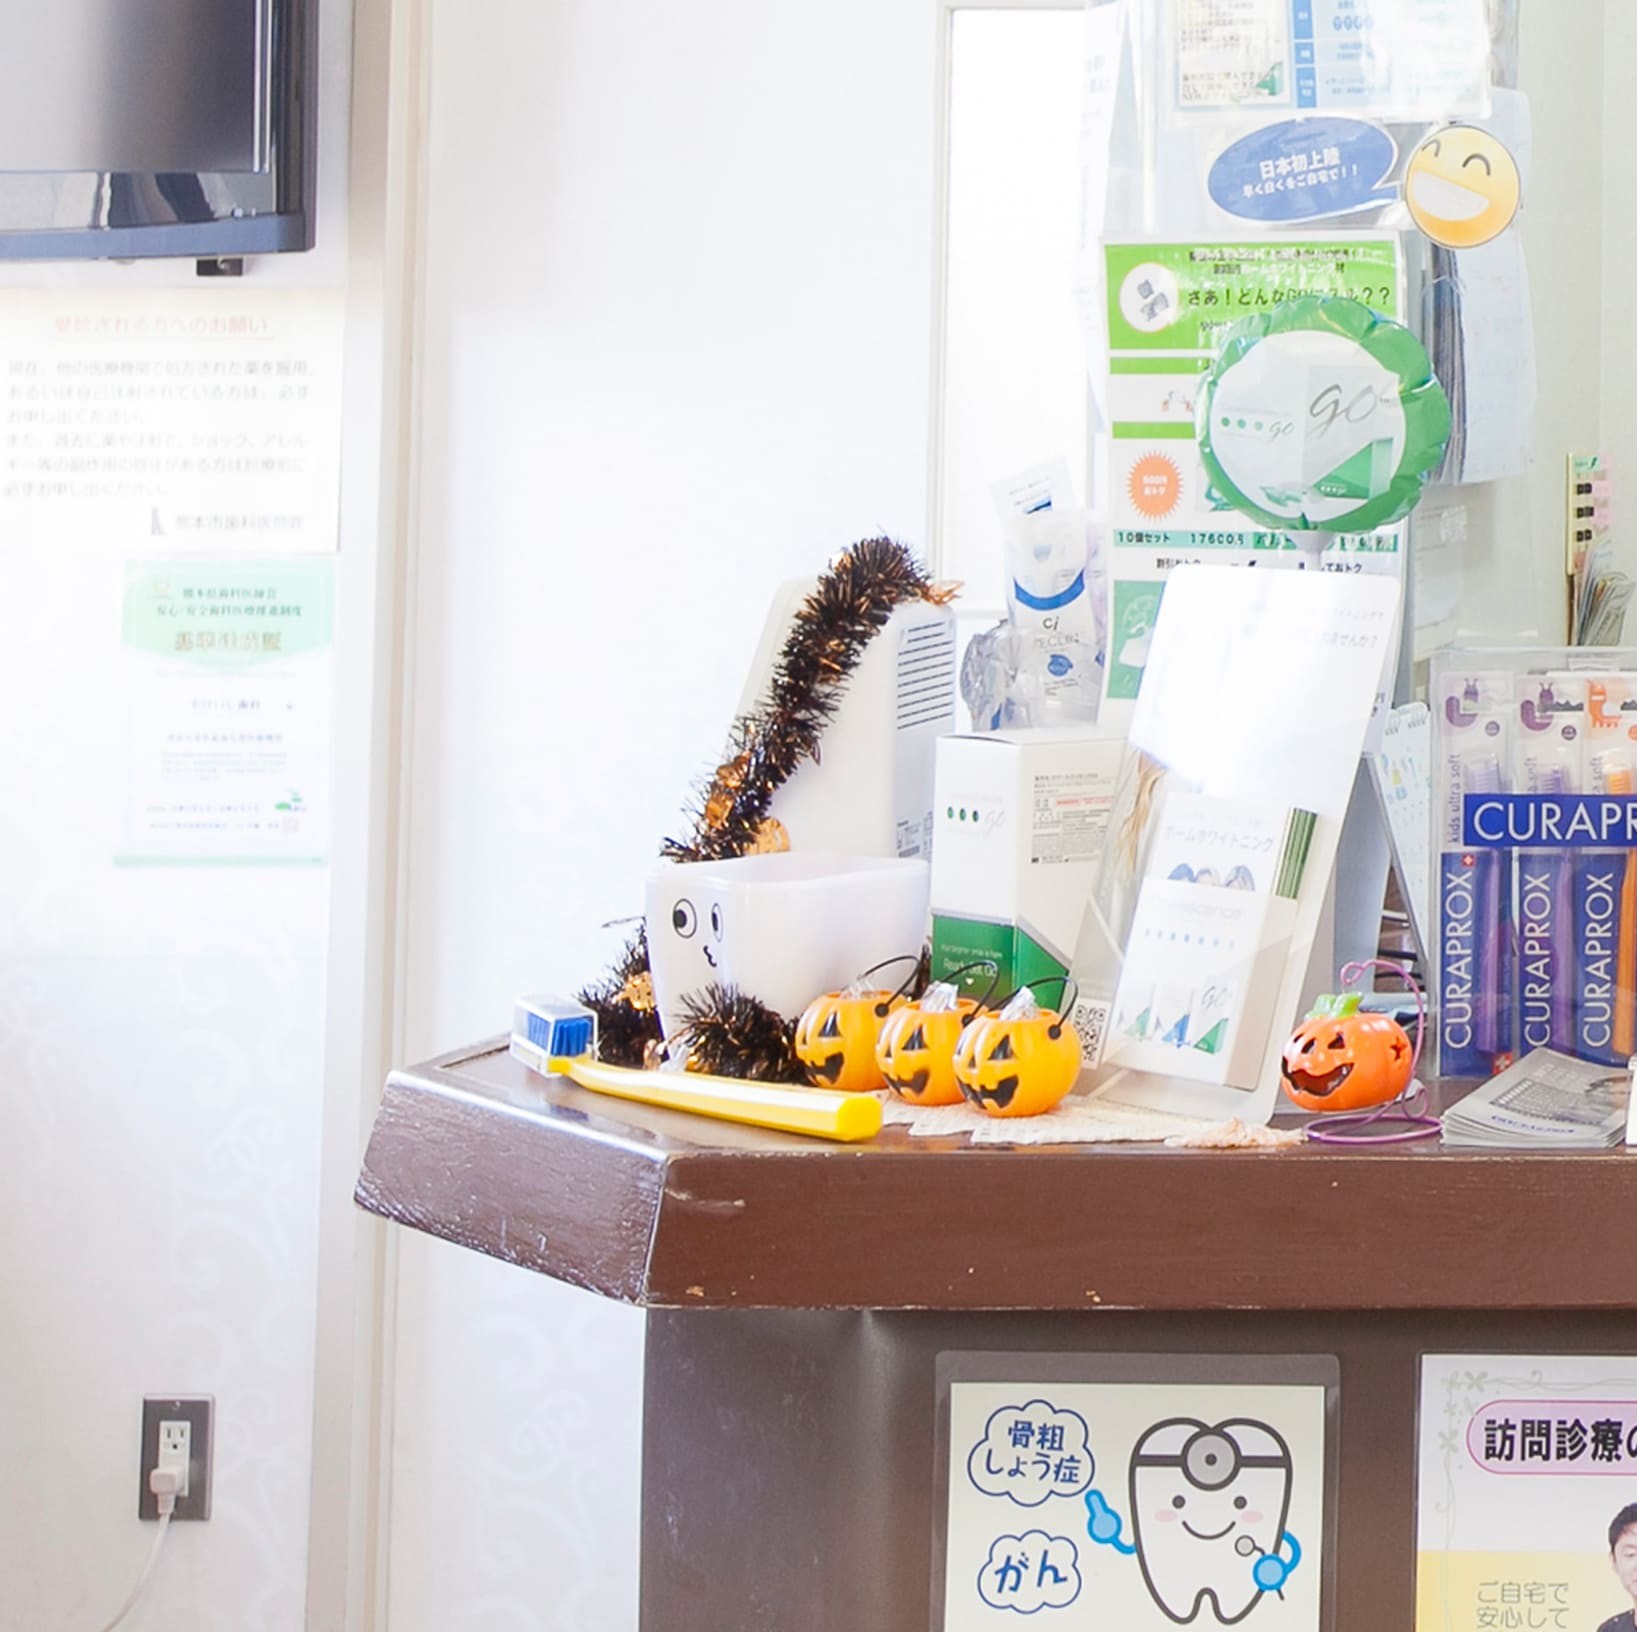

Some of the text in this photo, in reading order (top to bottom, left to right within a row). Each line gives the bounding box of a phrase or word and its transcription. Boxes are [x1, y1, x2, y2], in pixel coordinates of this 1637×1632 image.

[1448, 754, 1461, 844] kids soft
[1445, 870, 1473, 1048] CURAPROX
[1524, 872, 1551, 1047] CURAPROX
[1583, 872, 1614, 1048] CURAPROX
[1009, 1420, 1064, 1451] 骨粗
[985, 1448, 1081, 1483] しょう症
[994, 1550, 1068, 1593] がん
[1478, 1581, 1569, 1604] ご自宅で
[1477, 1606, 1570, 1629] 安心して
